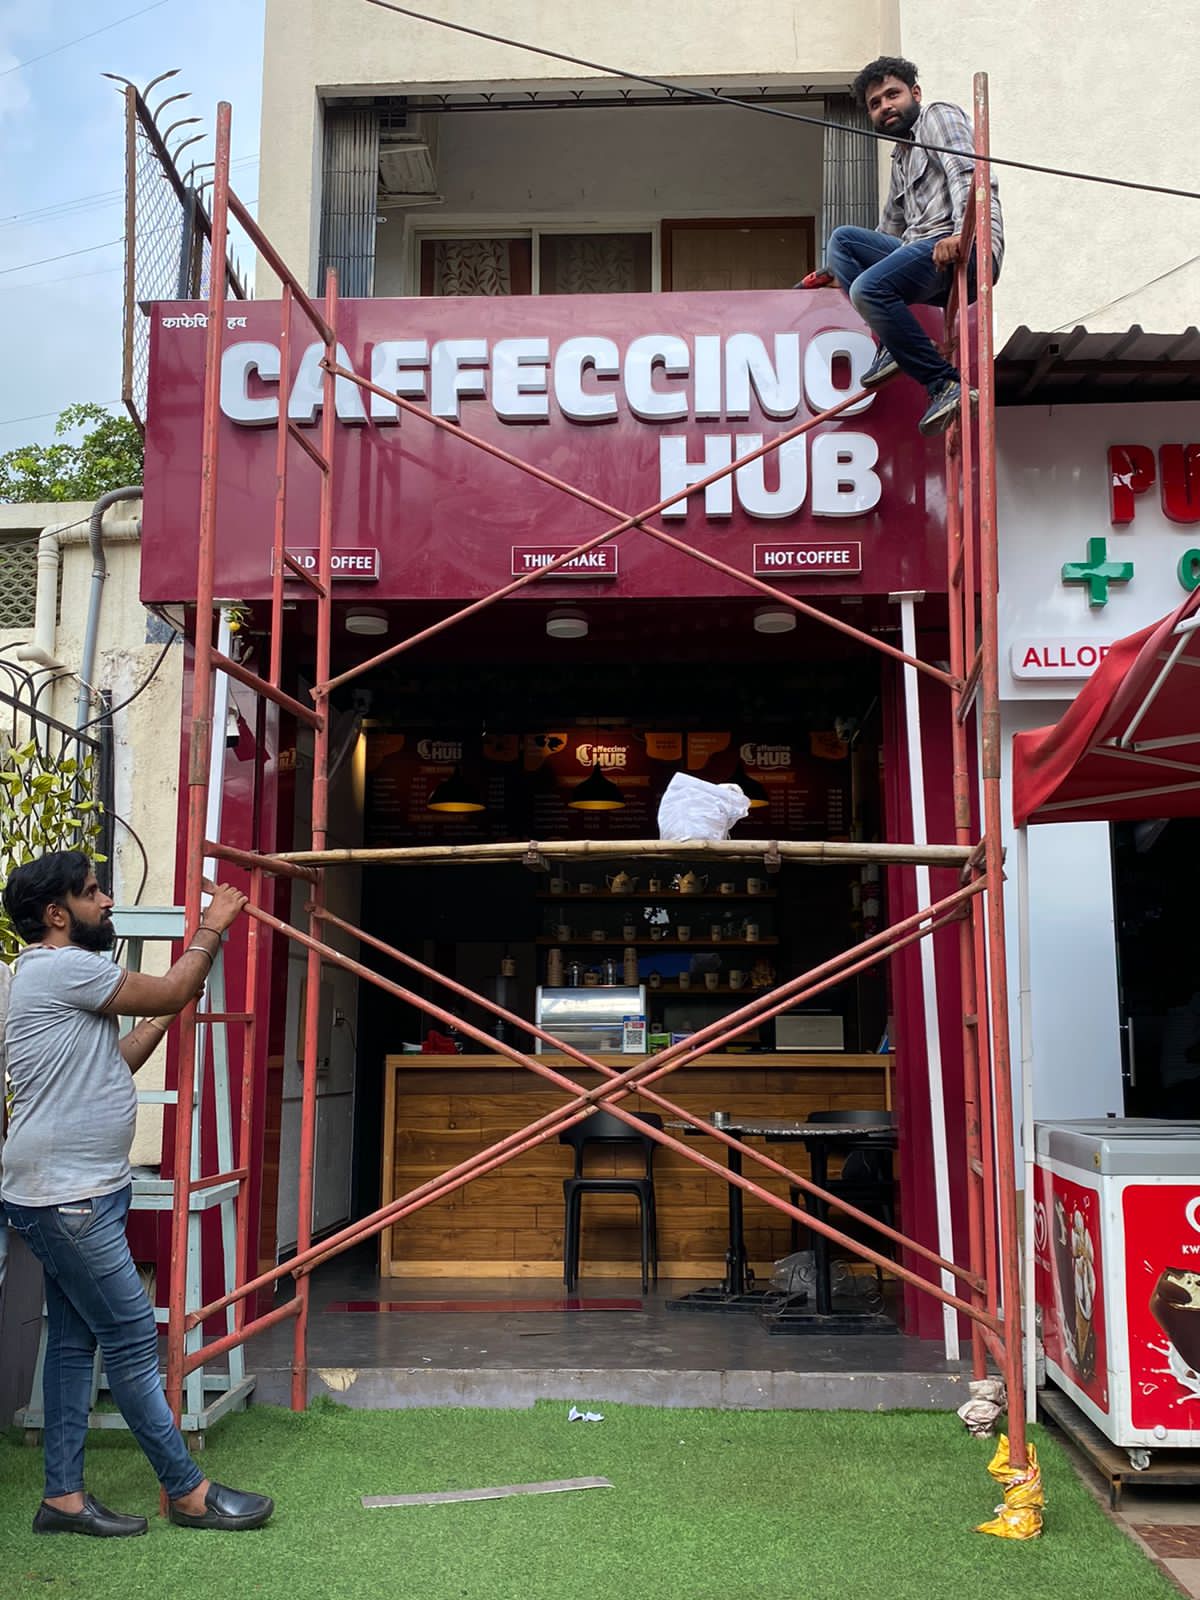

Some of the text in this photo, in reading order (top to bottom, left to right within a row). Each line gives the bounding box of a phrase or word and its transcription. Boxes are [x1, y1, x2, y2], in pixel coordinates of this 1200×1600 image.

[219, 330, 879, 427] CAFFECCINO
[659, 432, 882, 519] HUB
[1108, 443, 1200, 524] PU
[330, 555, 373, 569] OFFEE
[764, 549, 850, 566] HOT COFFEE
[592, 753, 627, 767] HUB
[756, 751, 791, 766] HUB
